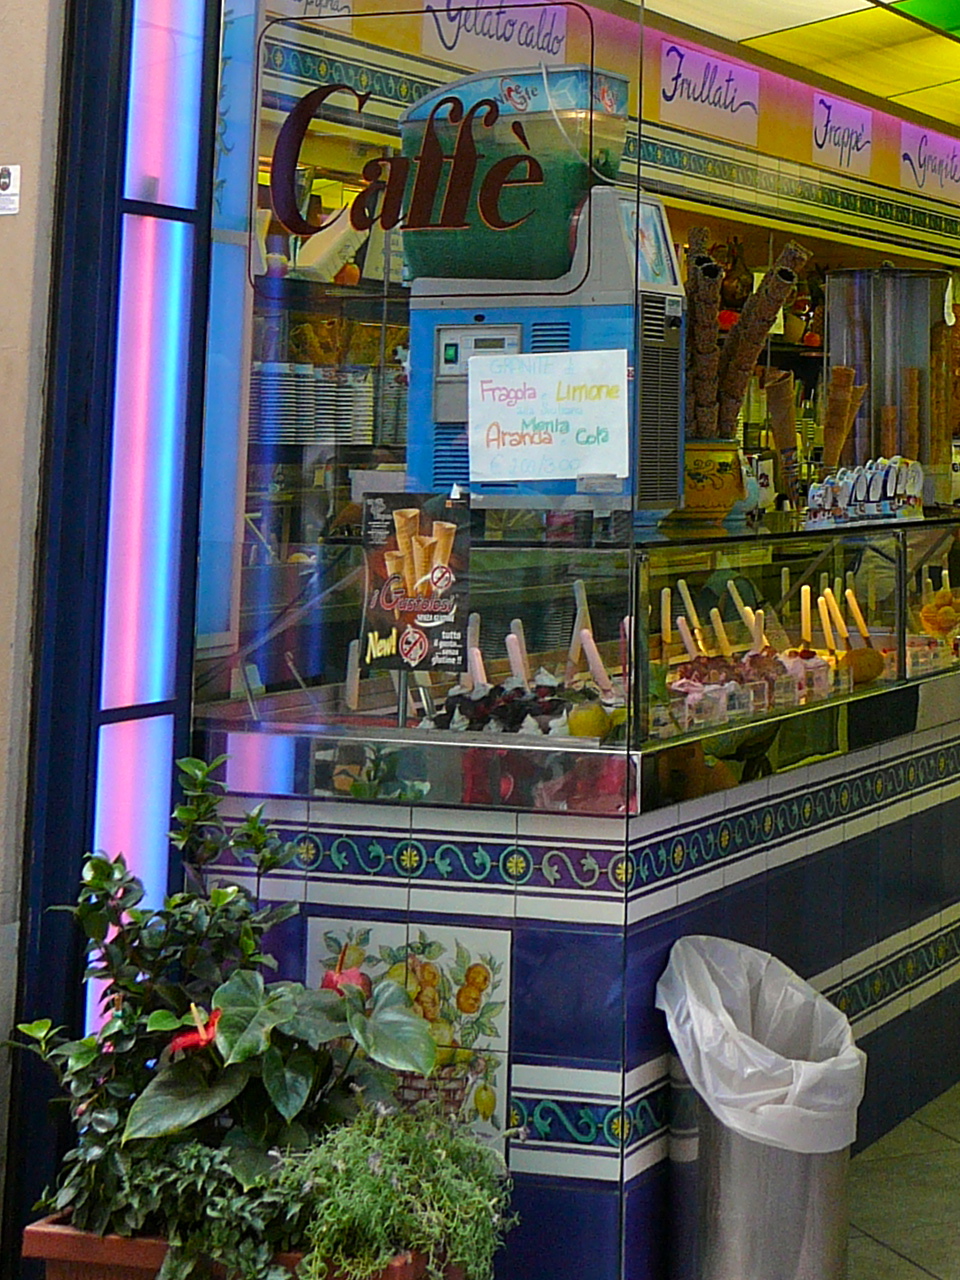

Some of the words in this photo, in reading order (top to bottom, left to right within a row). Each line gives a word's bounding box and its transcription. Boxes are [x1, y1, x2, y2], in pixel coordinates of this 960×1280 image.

[517, 7, 566, 55] caldo
[661, 45, 759, 116] Frullati
[270, 84, 545, 237] Caffè
[479, 379, 537, 407] Fragola
[555, 380, 621, 403] Limone
[521, 417, 571, 435] Menta
[575, 425, 610, 446] Cola
[365, 626, 398, 664] New!
